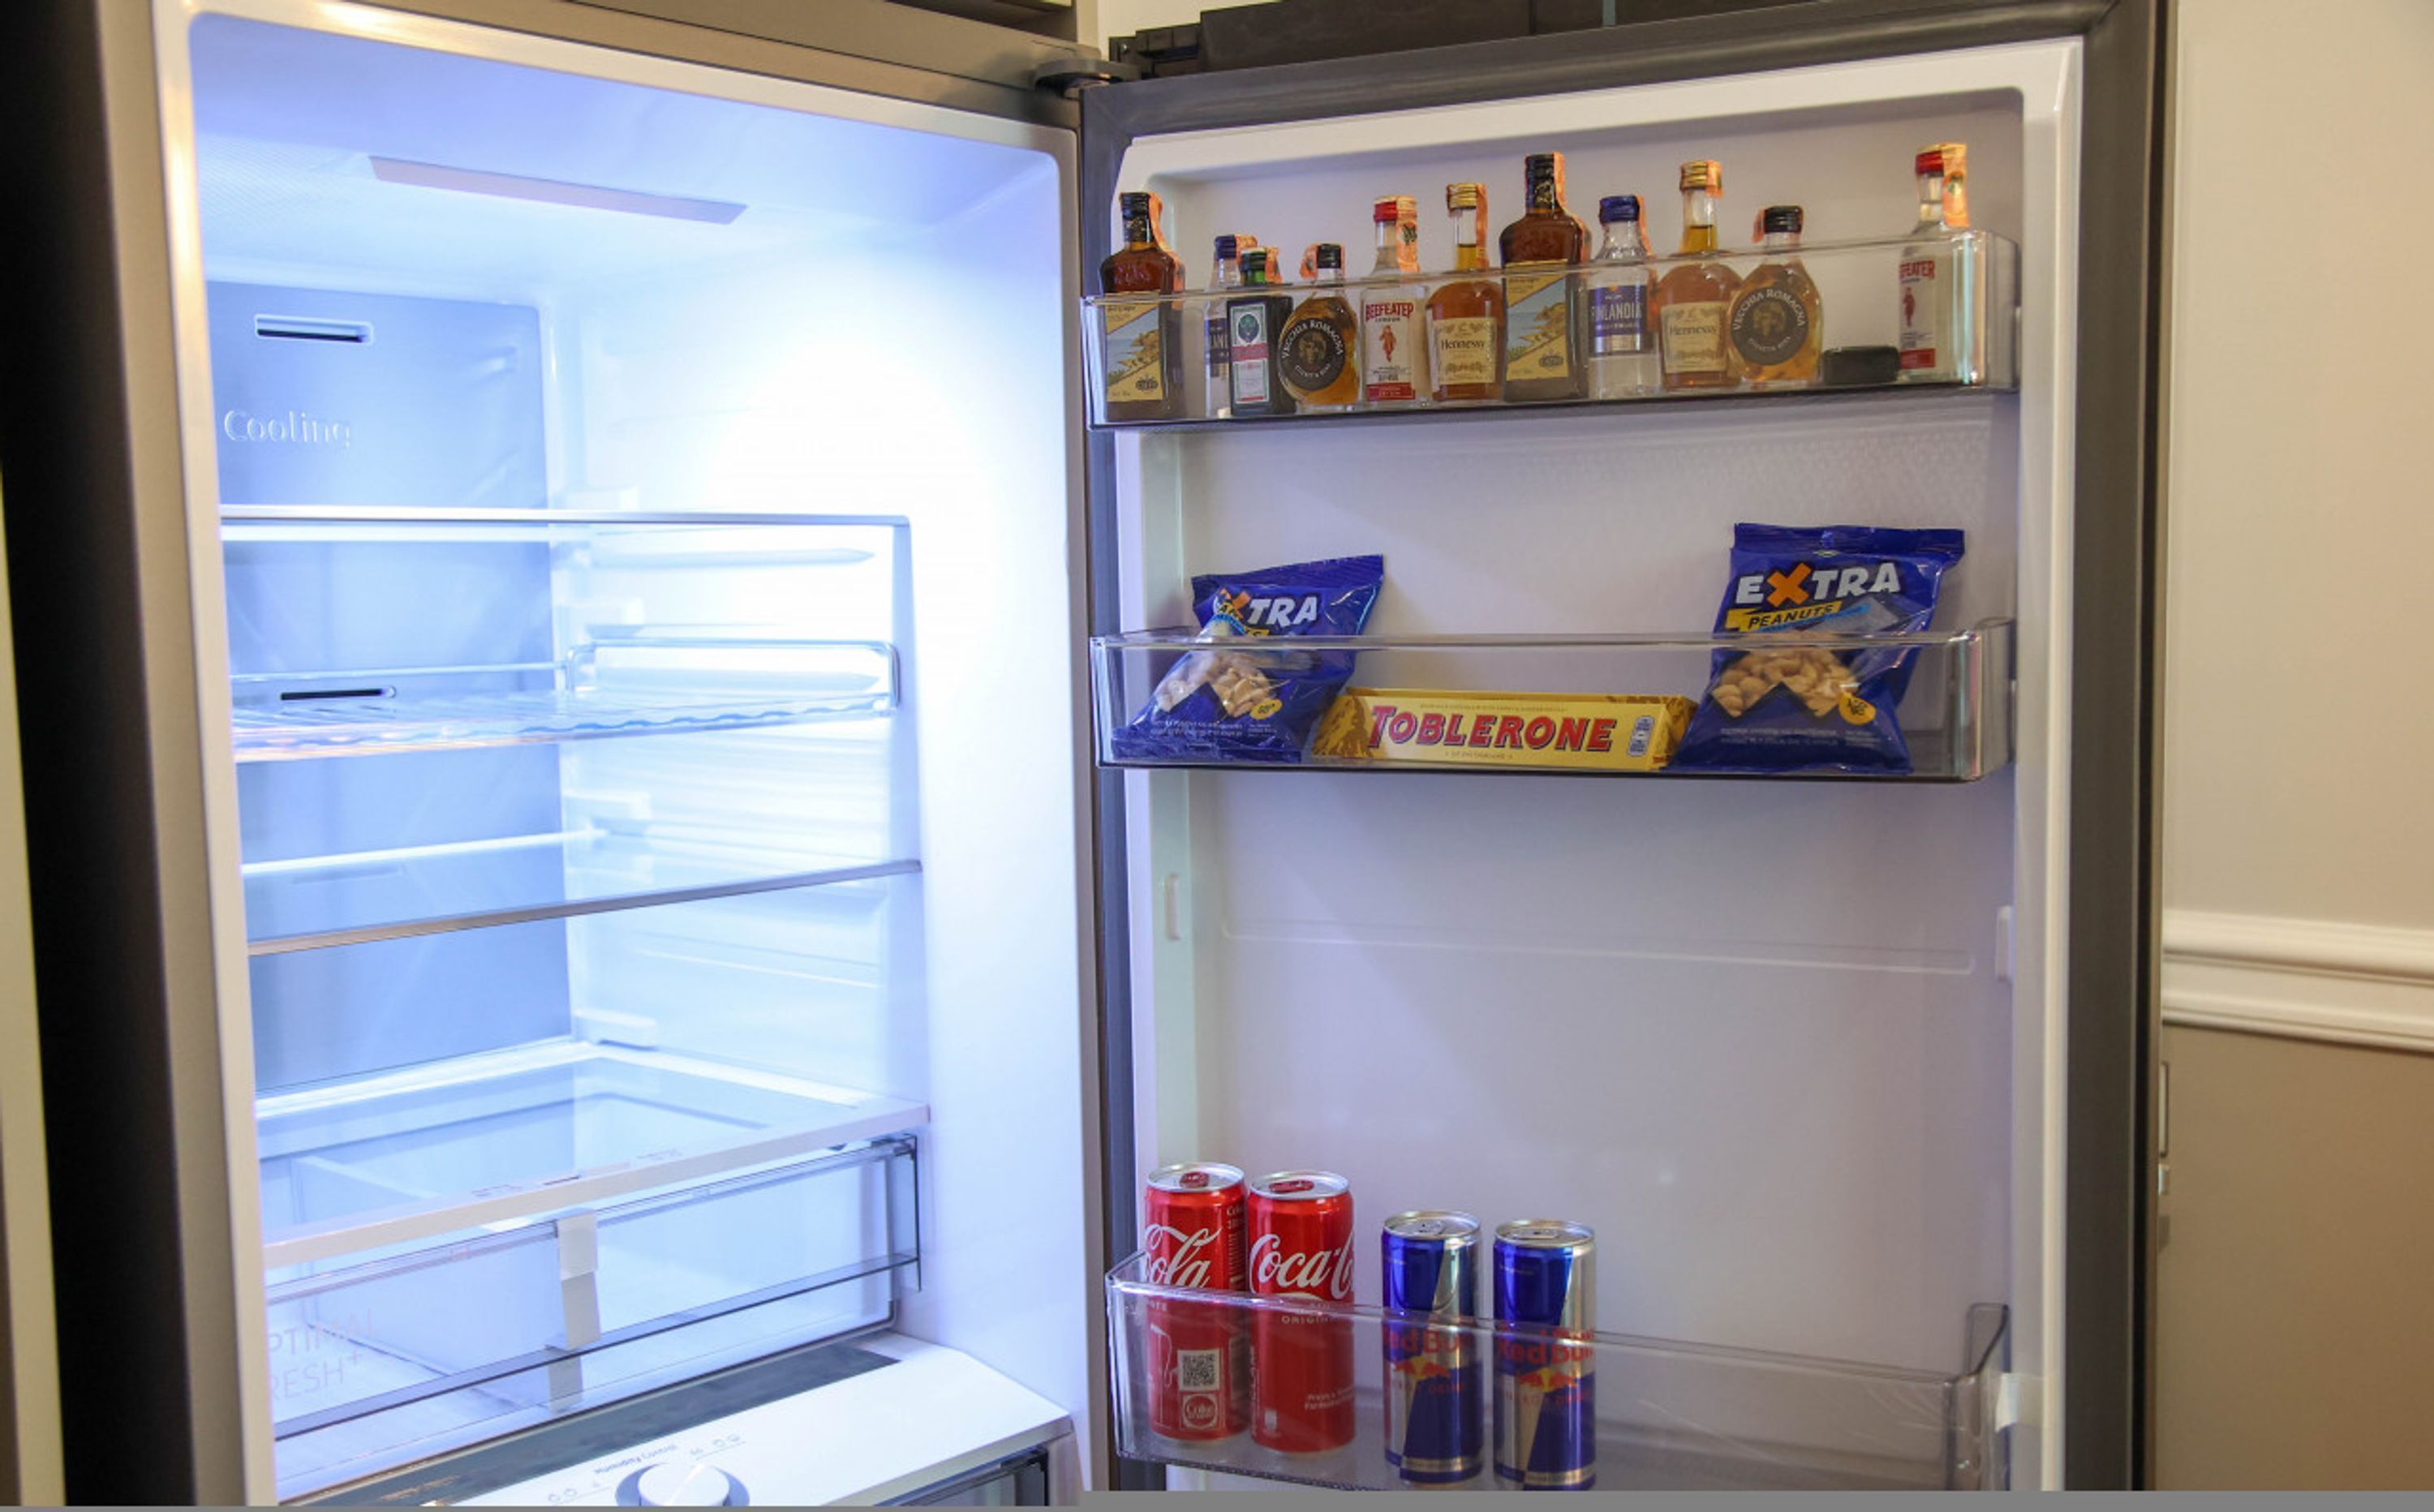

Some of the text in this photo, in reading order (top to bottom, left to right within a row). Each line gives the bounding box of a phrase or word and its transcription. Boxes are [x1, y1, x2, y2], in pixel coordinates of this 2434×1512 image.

[1441, 339, 1485, 350] Hennessy
[224, 410, 351, 449] Cooling
[1735, 562, 1901, 608] EXTRA
[1368, 705, 1616, 752] TOBLERONE
